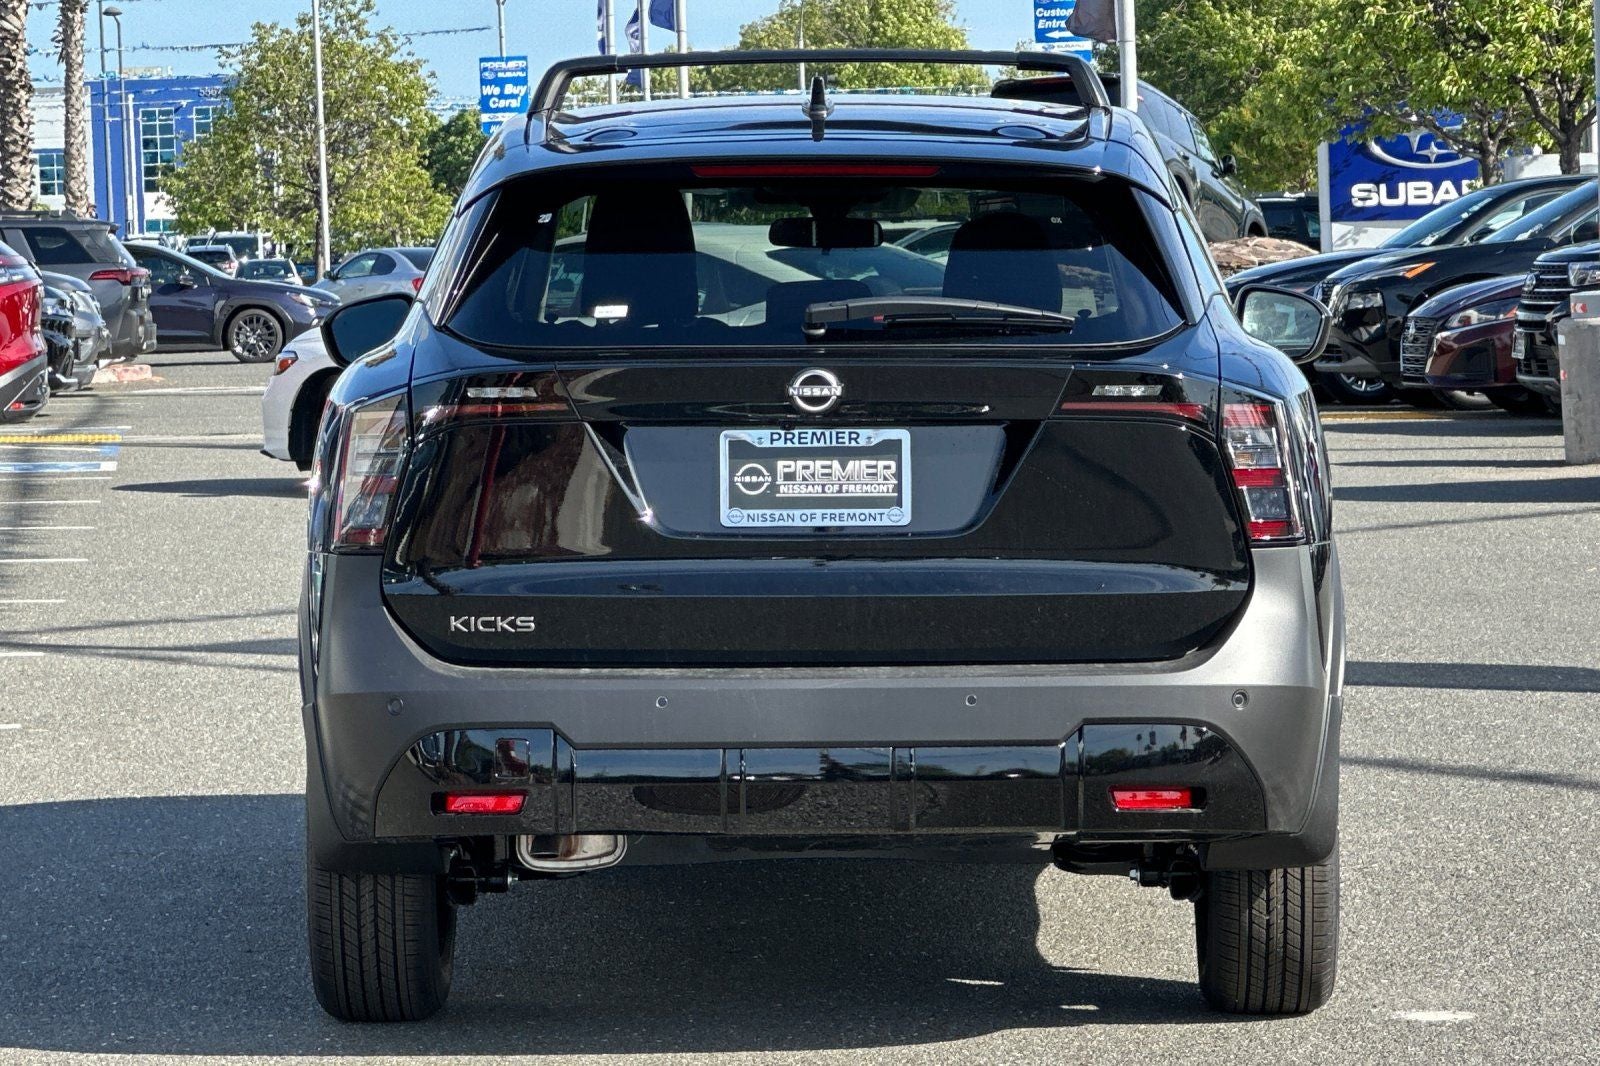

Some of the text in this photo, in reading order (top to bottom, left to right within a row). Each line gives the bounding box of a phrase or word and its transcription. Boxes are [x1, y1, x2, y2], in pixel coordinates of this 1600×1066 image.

[480, 61, 527, 70] PREMIER
[482, 84, 527, 97] We Buy
[489, 97, 521, 108] Cars!
[789, 387, 842, 396] NISSAN
[769, 431, 861, 445] PREMIER
[776, 460, 898, 482] PREMIER
[733, 475, 772, 483] NISSAN
[779, 483, 894, 494] NISSAN OF FREMONT
[746, 513, 796, 523] NISSAN
[799, 513, 817, 523] OF
[821, 512, 886, 522] FREMONT
[449, 615, 536, 633] KICKS
